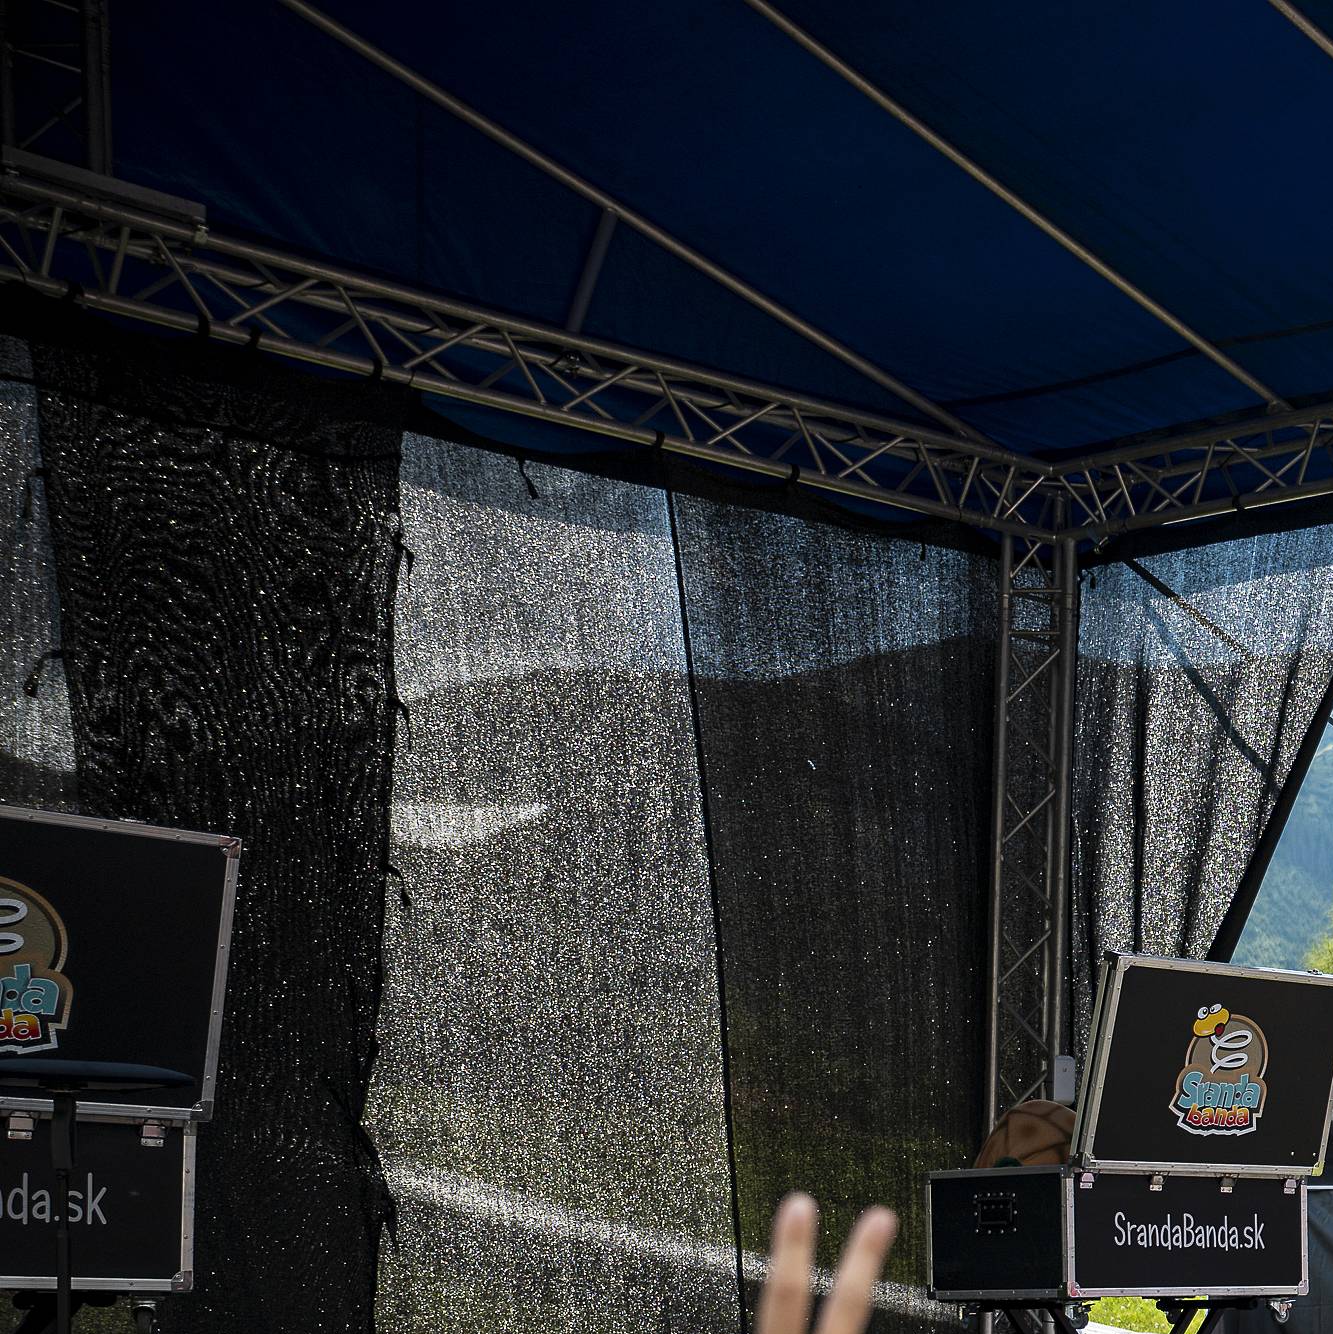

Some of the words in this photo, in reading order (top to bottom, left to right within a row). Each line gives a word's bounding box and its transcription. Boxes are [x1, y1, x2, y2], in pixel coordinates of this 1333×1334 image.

[1179, 1072, 1261, 1109] Sranda
[1186, 1104, 1249, 1127] banda
[1114, 1211, 1266, 1251] SrandaBanda.sk
